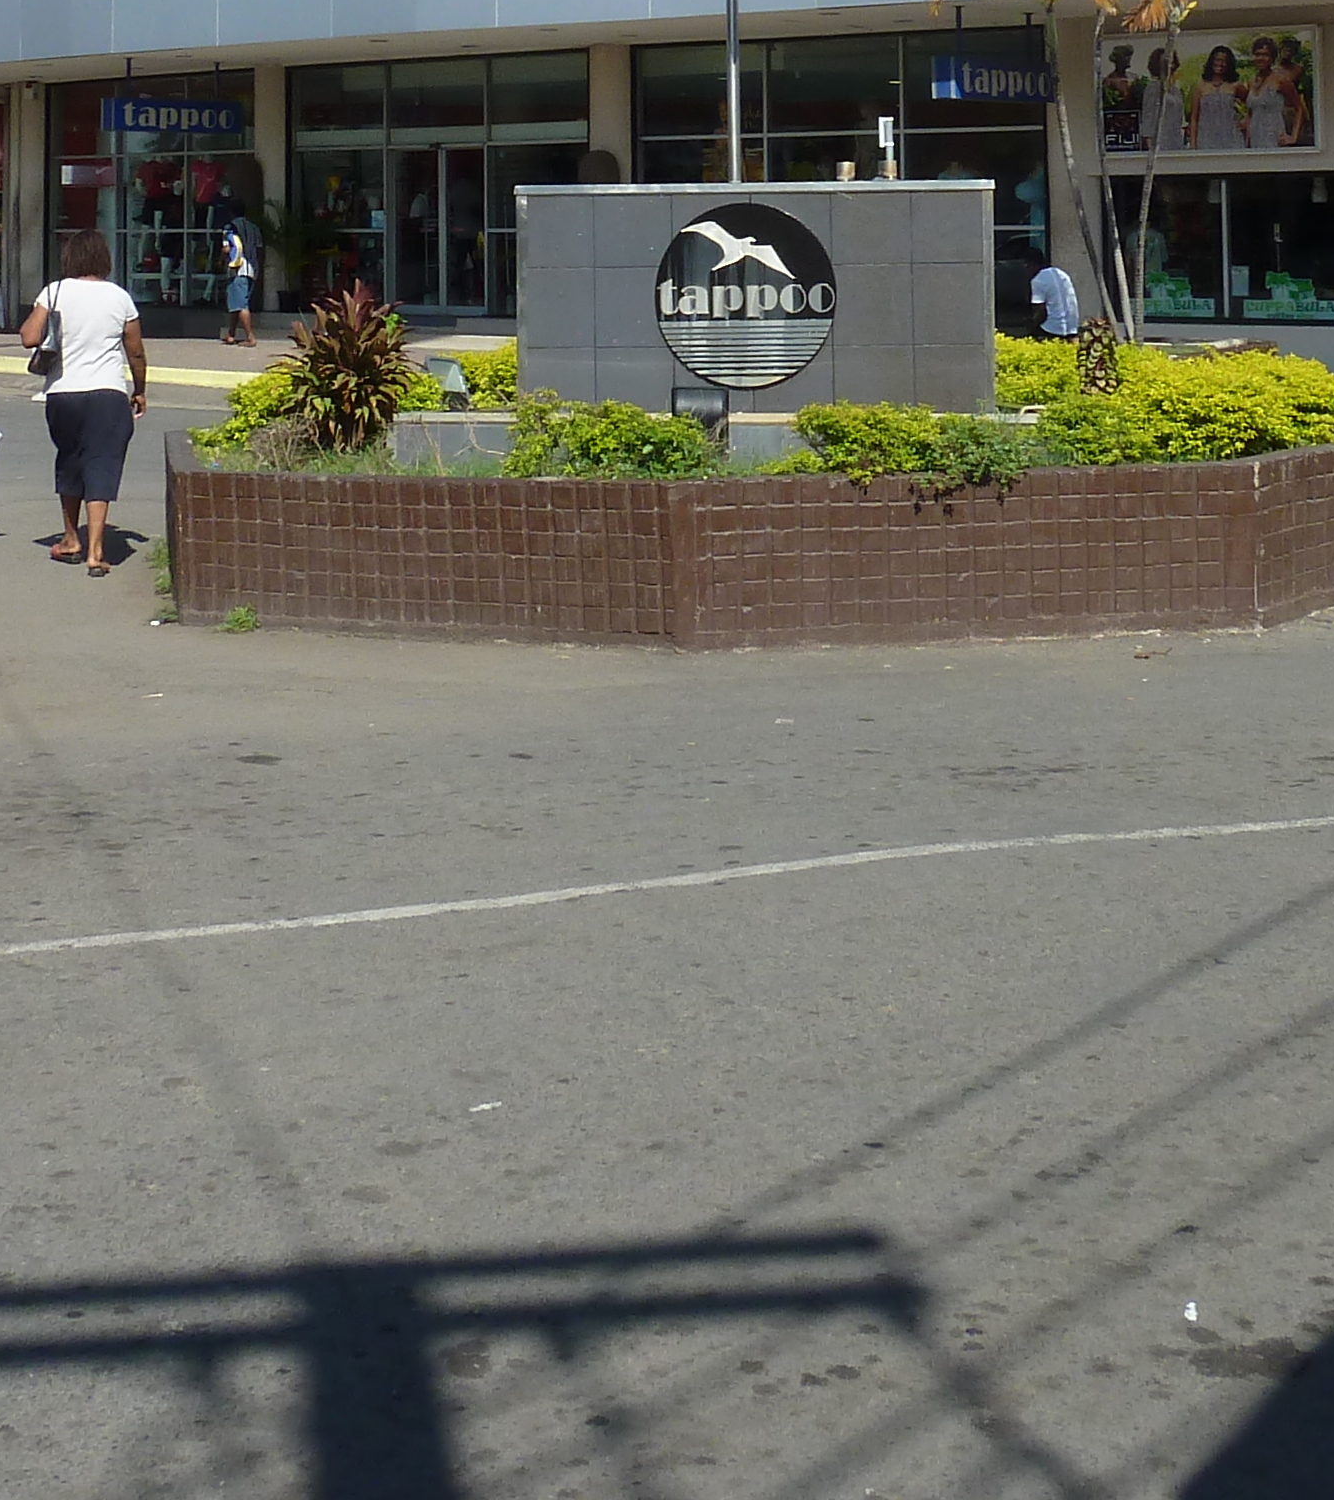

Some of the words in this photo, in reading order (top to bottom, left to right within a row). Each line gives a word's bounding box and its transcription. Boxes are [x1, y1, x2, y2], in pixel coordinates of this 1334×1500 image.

[961, 61, 1052, 98] tappoo
[122, 101, 235, 129] tappoo
[1105, 133, 1140, 144] FIJI
[656, 278, 835, 319] tappoo
